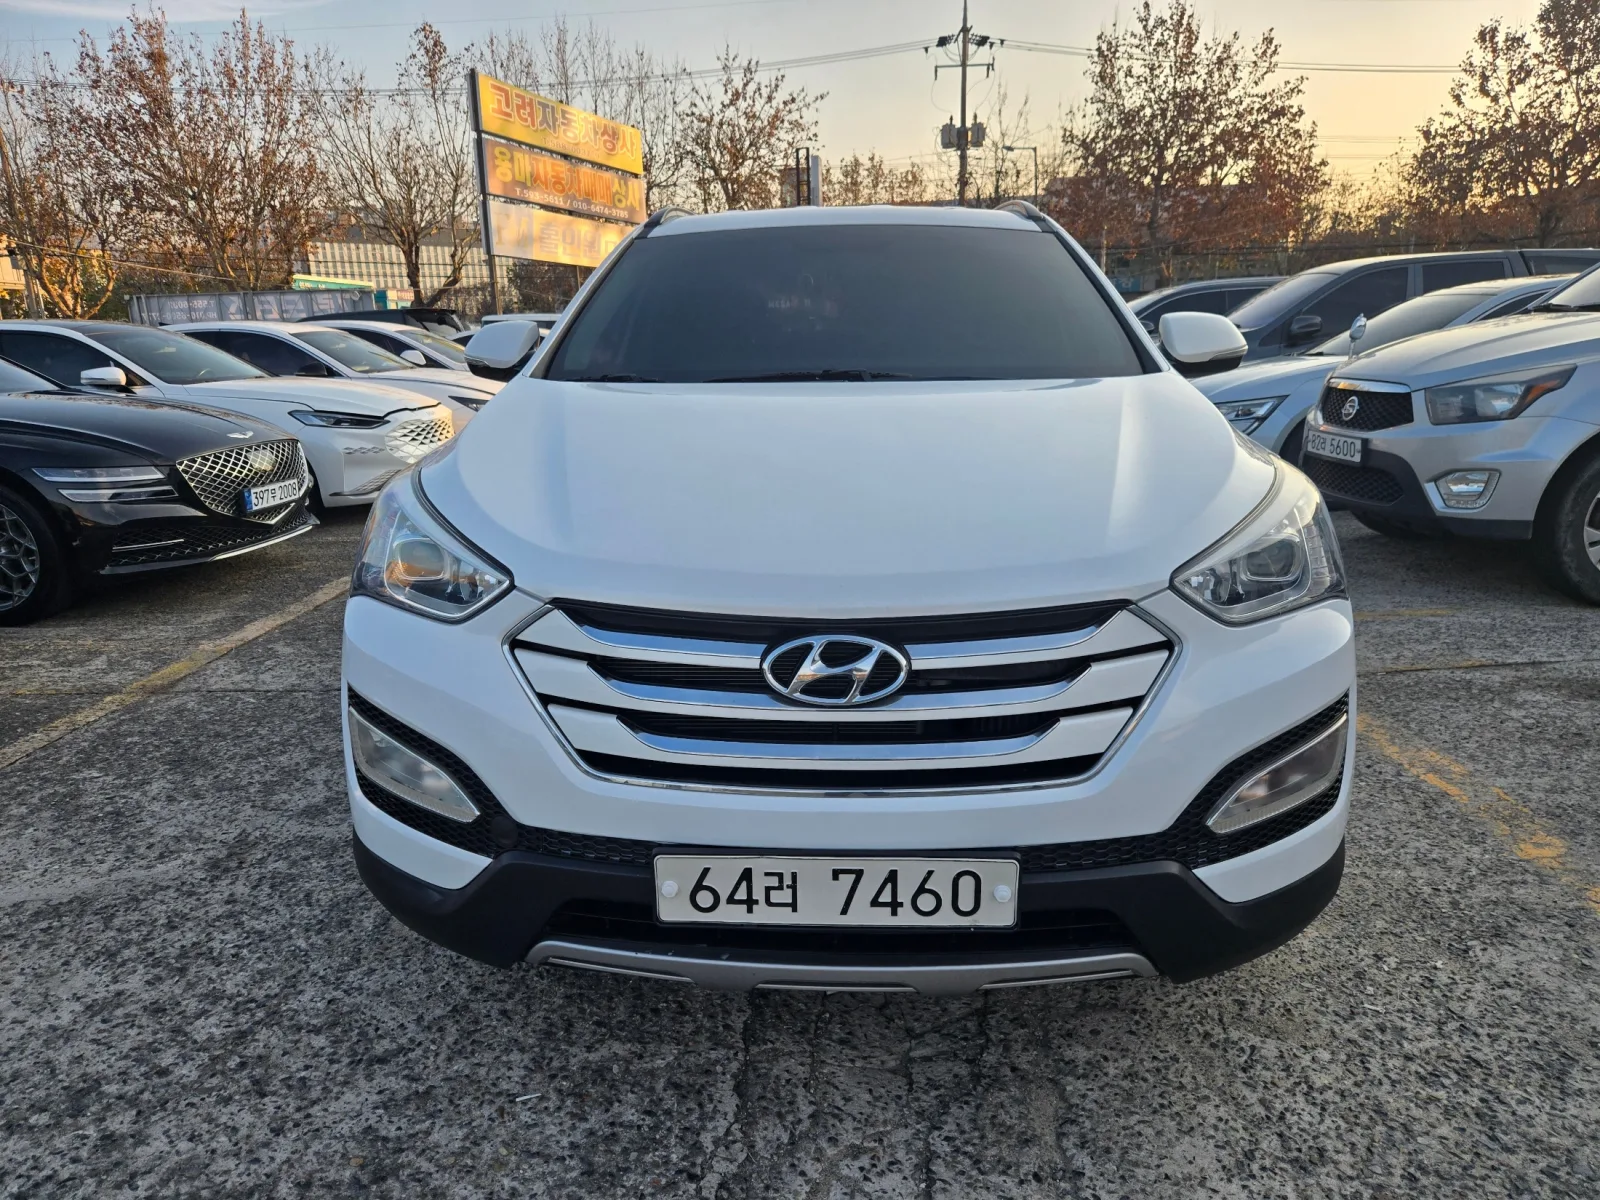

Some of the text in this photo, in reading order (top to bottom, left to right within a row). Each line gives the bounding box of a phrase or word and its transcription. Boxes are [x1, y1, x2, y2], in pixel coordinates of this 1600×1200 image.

[490, 82, 637, 159] 고려자동차상사
[1330, 438, 1356, 458] 5600
[253, 482, 298, 506] 397무 2008
[689, 866, 982, 917] 64러 7460
